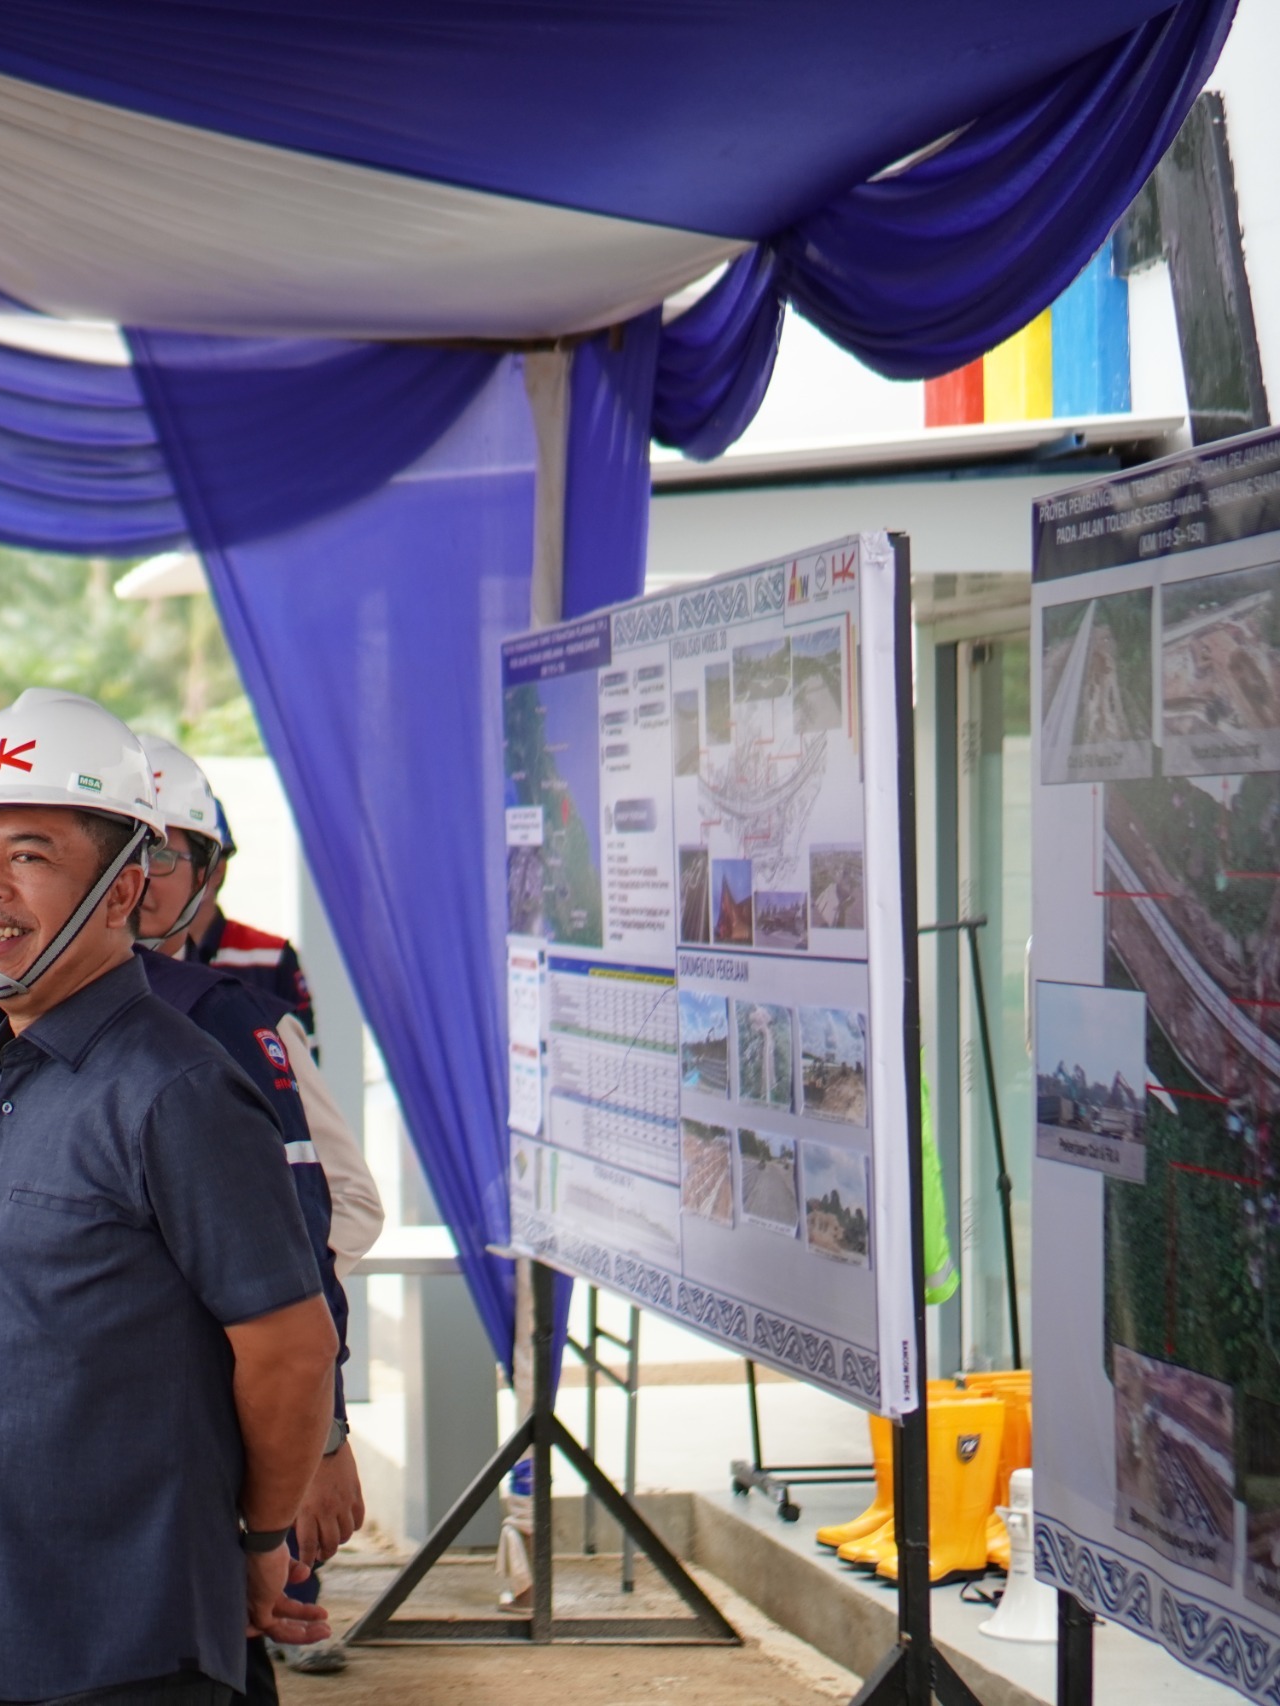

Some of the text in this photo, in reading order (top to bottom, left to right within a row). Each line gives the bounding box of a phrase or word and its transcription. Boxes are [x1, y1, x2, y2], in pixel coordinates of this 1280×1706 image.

[1039, 500, 1067, 523] PROYEK
[1068, 484, 1130, 515] PEMBANGUNAN
[1131, 473, 1167, 498] TEMPAT
[1056, 524, 1077, 545] PADA
[1078, 517, 1104, 540] JALAN
[1142, 493, 1201, 524] SERBELAWAN
[79, 776, 101, 789] MSA
